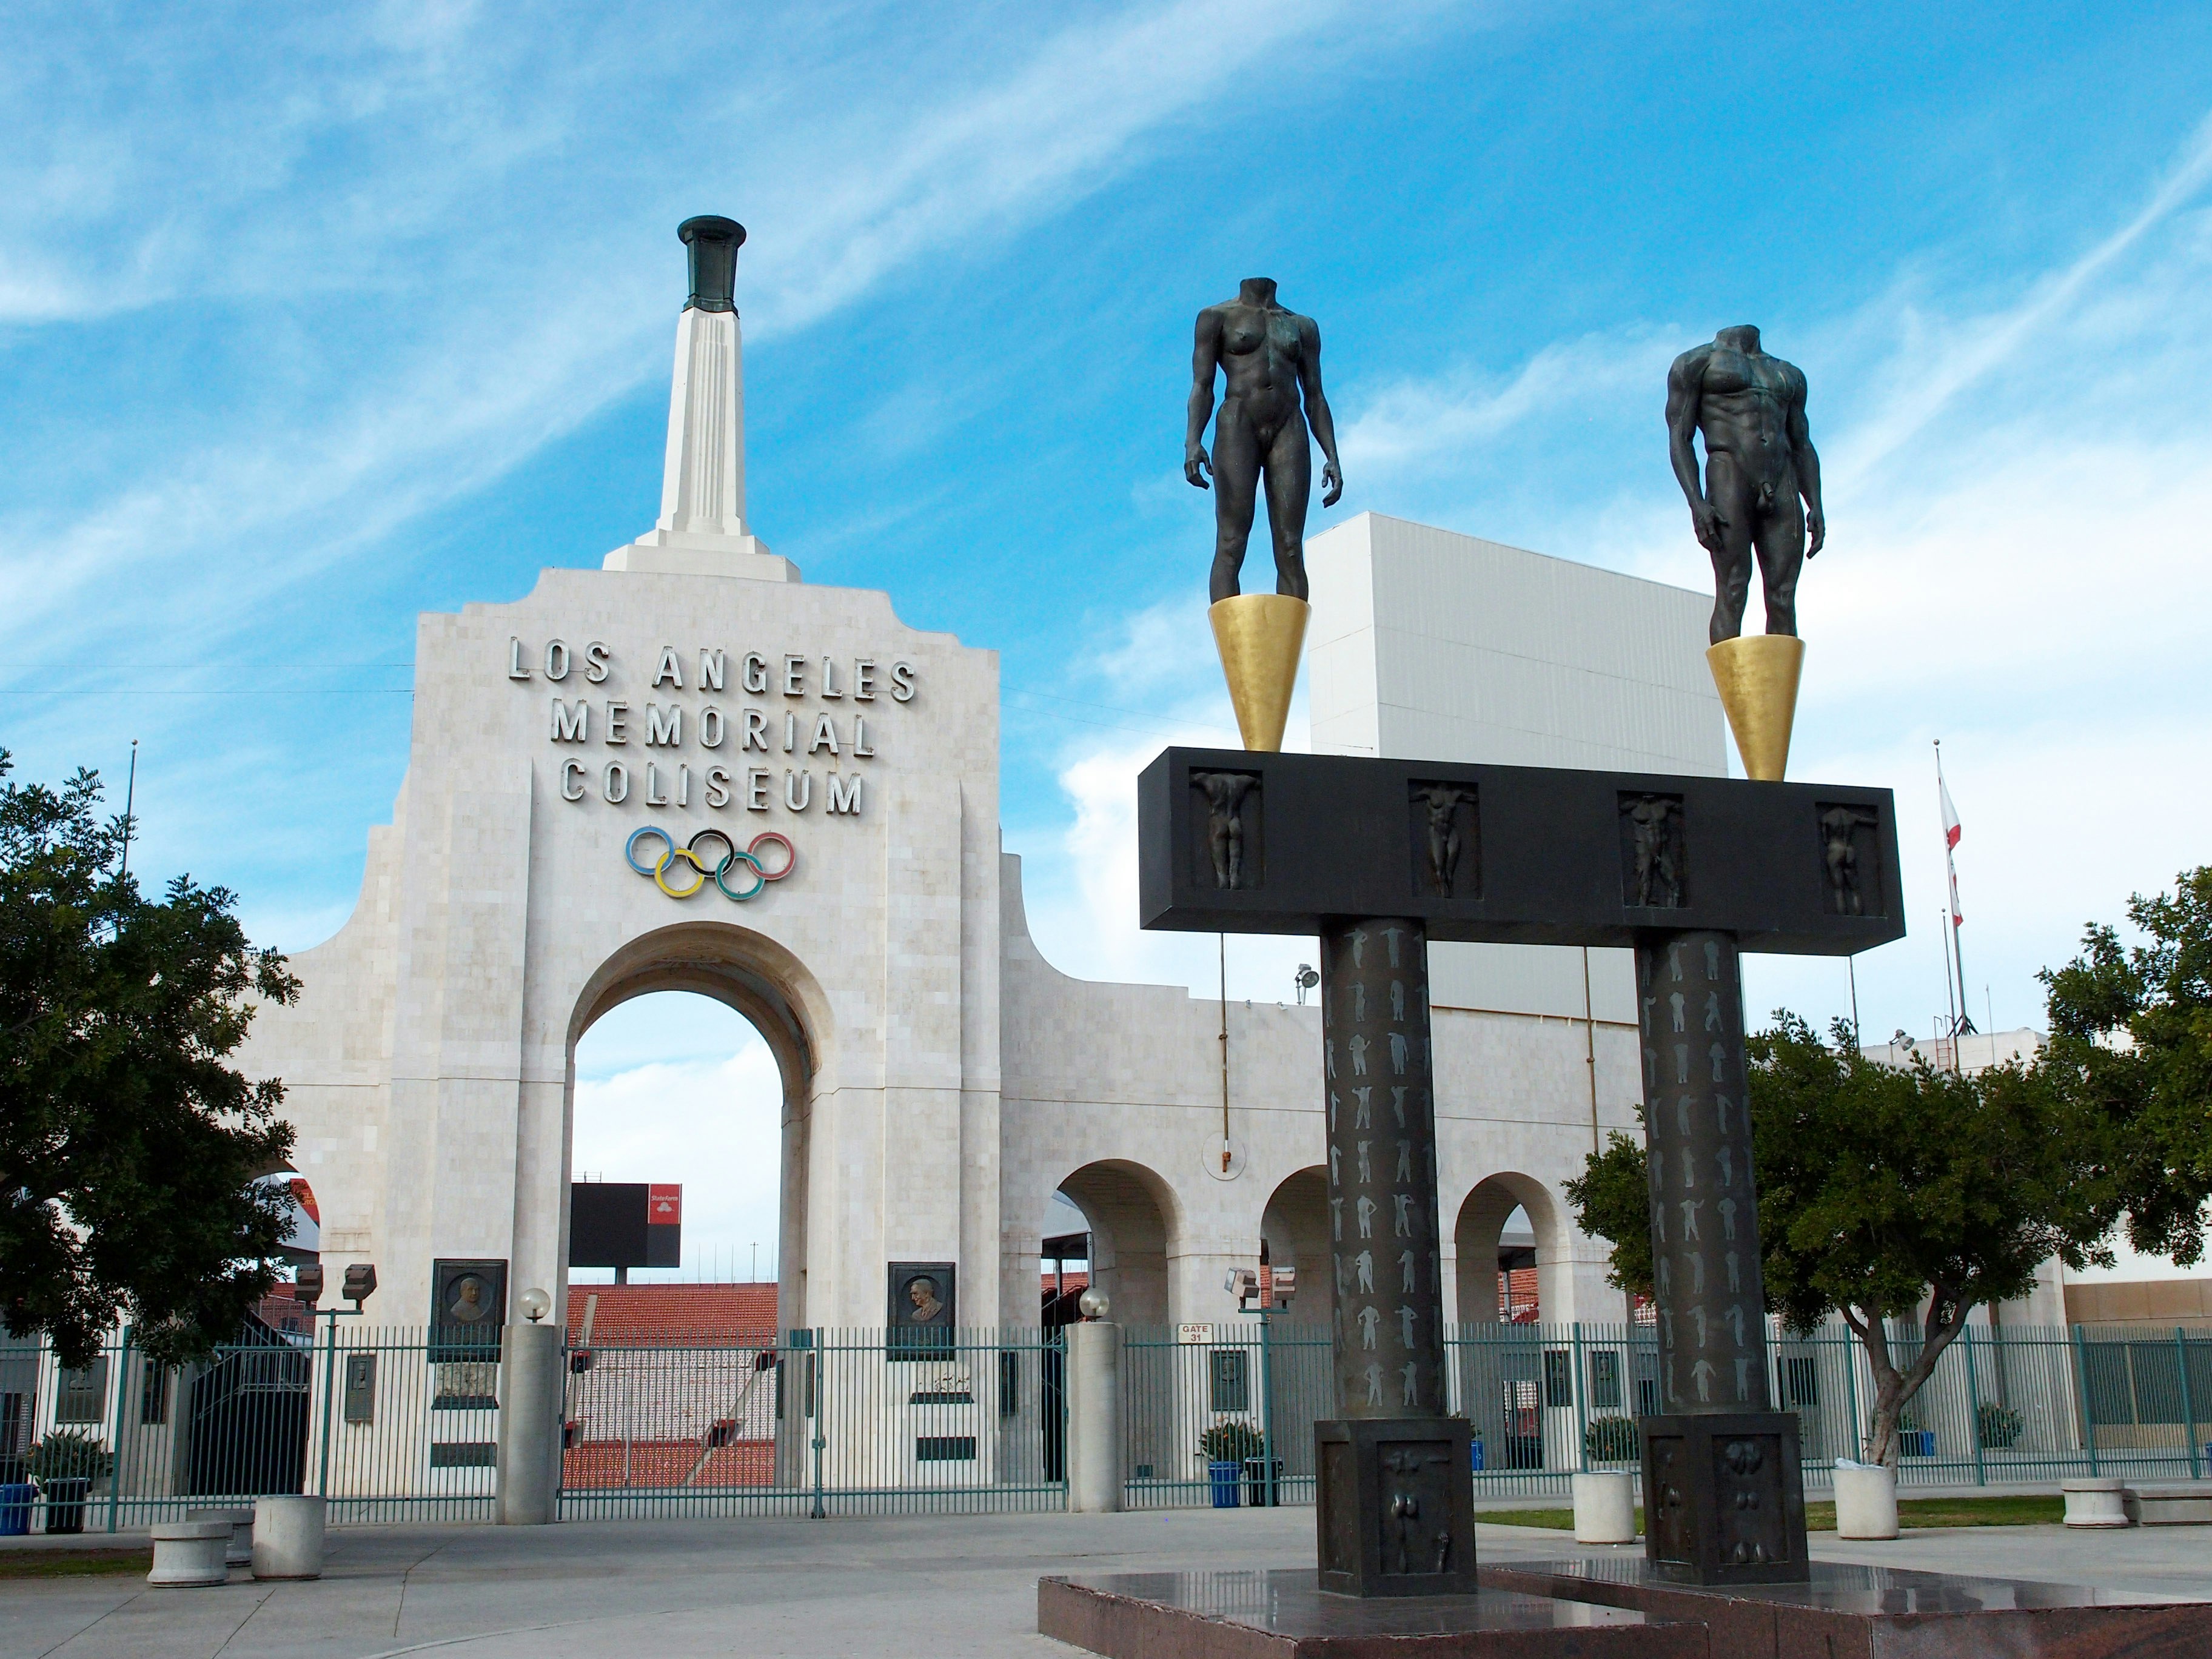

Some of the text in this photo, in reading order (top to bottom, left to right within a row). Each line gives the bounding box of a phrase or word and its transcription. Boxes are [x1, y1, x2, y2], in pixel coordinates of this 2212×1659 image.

[509, 636, 915, 702] LOS ANGELES
[551, 698, 875, 757] MEMORIAL
[560, 758, 861, 816] COLISEUM
